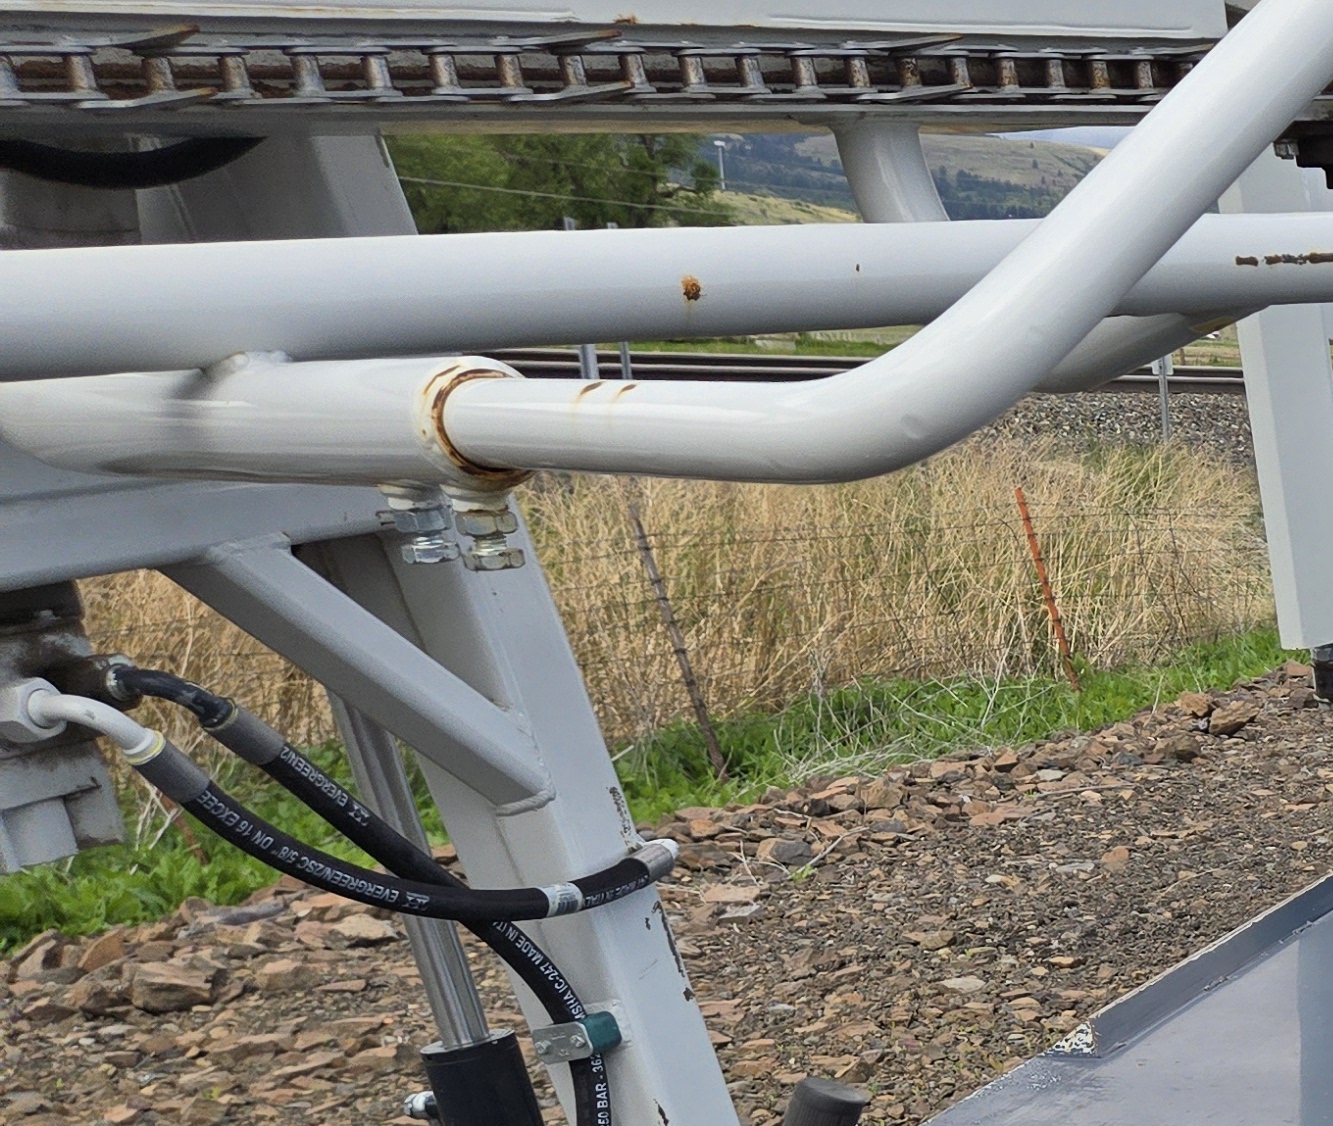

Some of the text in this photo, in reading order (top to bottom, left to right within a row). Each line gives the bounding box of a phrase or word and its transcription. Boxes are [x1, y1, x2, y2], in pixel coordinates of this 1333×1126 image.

[235, 820, 254, 836] 16
[251, 830, 274, 850] DN
[505, 926, 519, 942] IN
[515, 934, 544, 966] MADE
[595, 1082, 608, 1109] BAR
